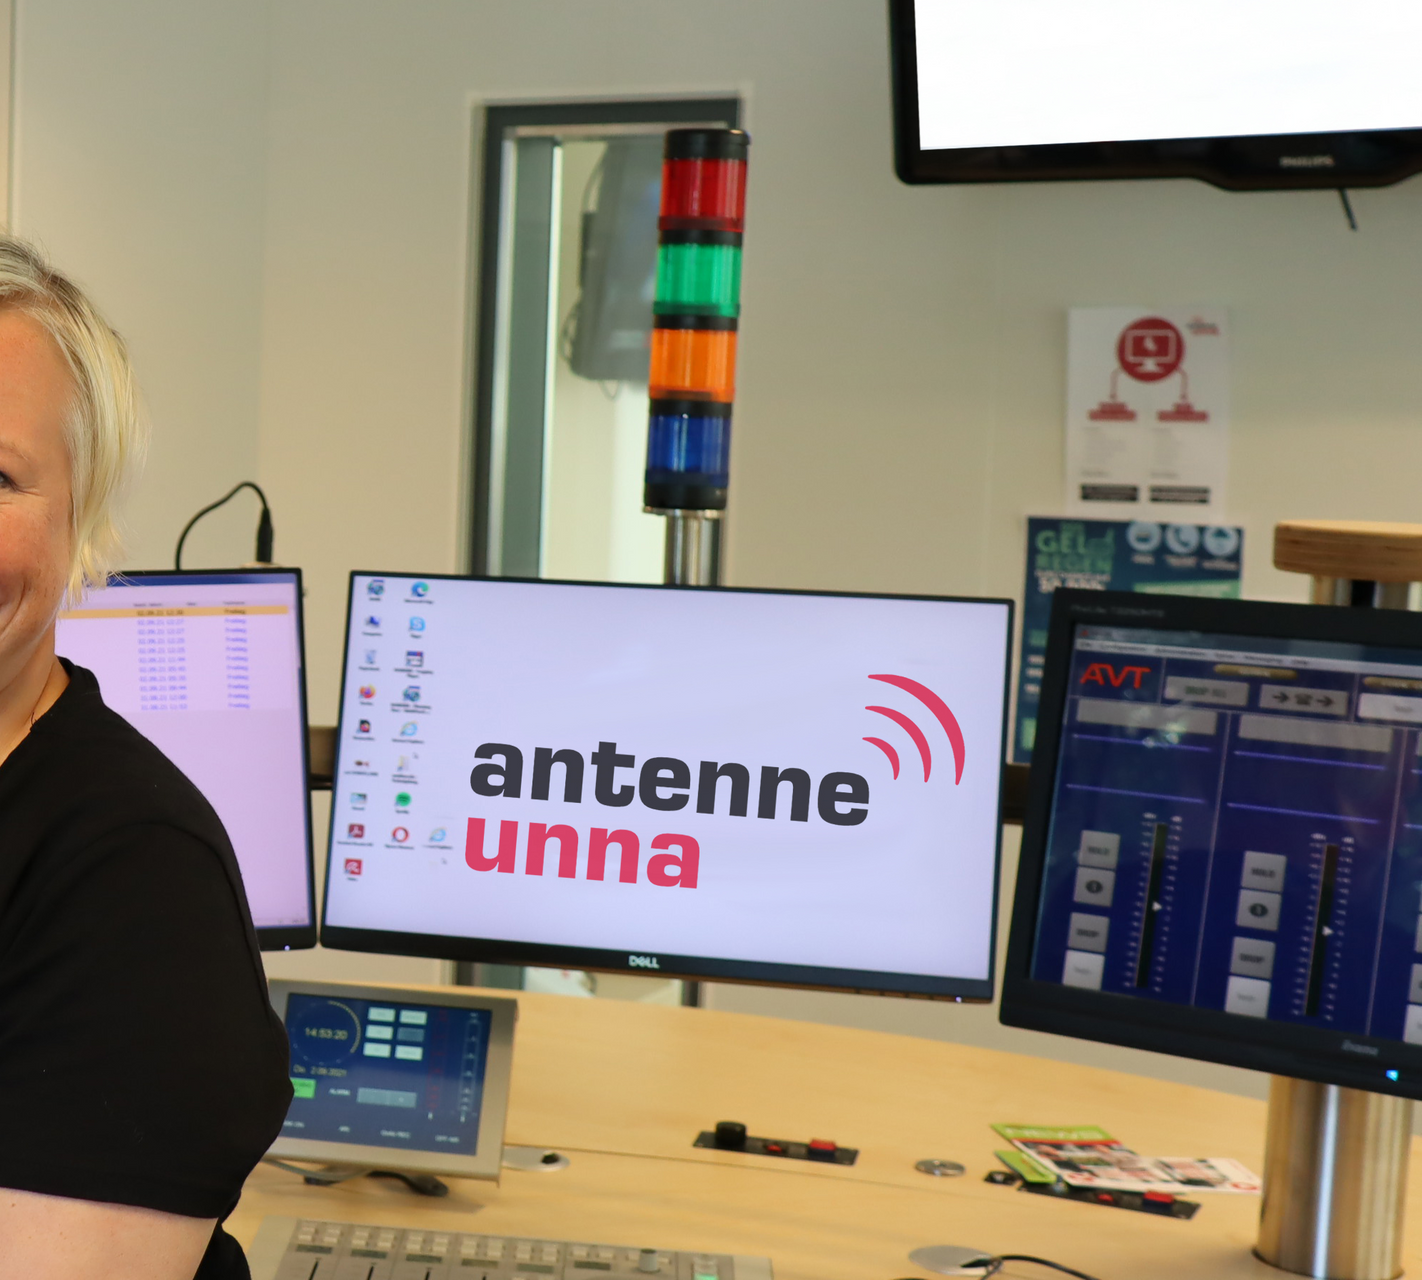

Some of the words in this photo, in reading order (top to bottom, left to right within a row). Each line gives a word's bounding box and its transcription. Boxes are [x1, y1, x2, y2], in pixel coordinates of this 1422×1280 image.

[1080, 662, 1151, 690] AVT
[470, 741, 869, 827] antenne
[464, 816, 700, 890] unna
[628, 954, 660, 970] DELL
[305, 1027, 348, 1040] 14:53:20
